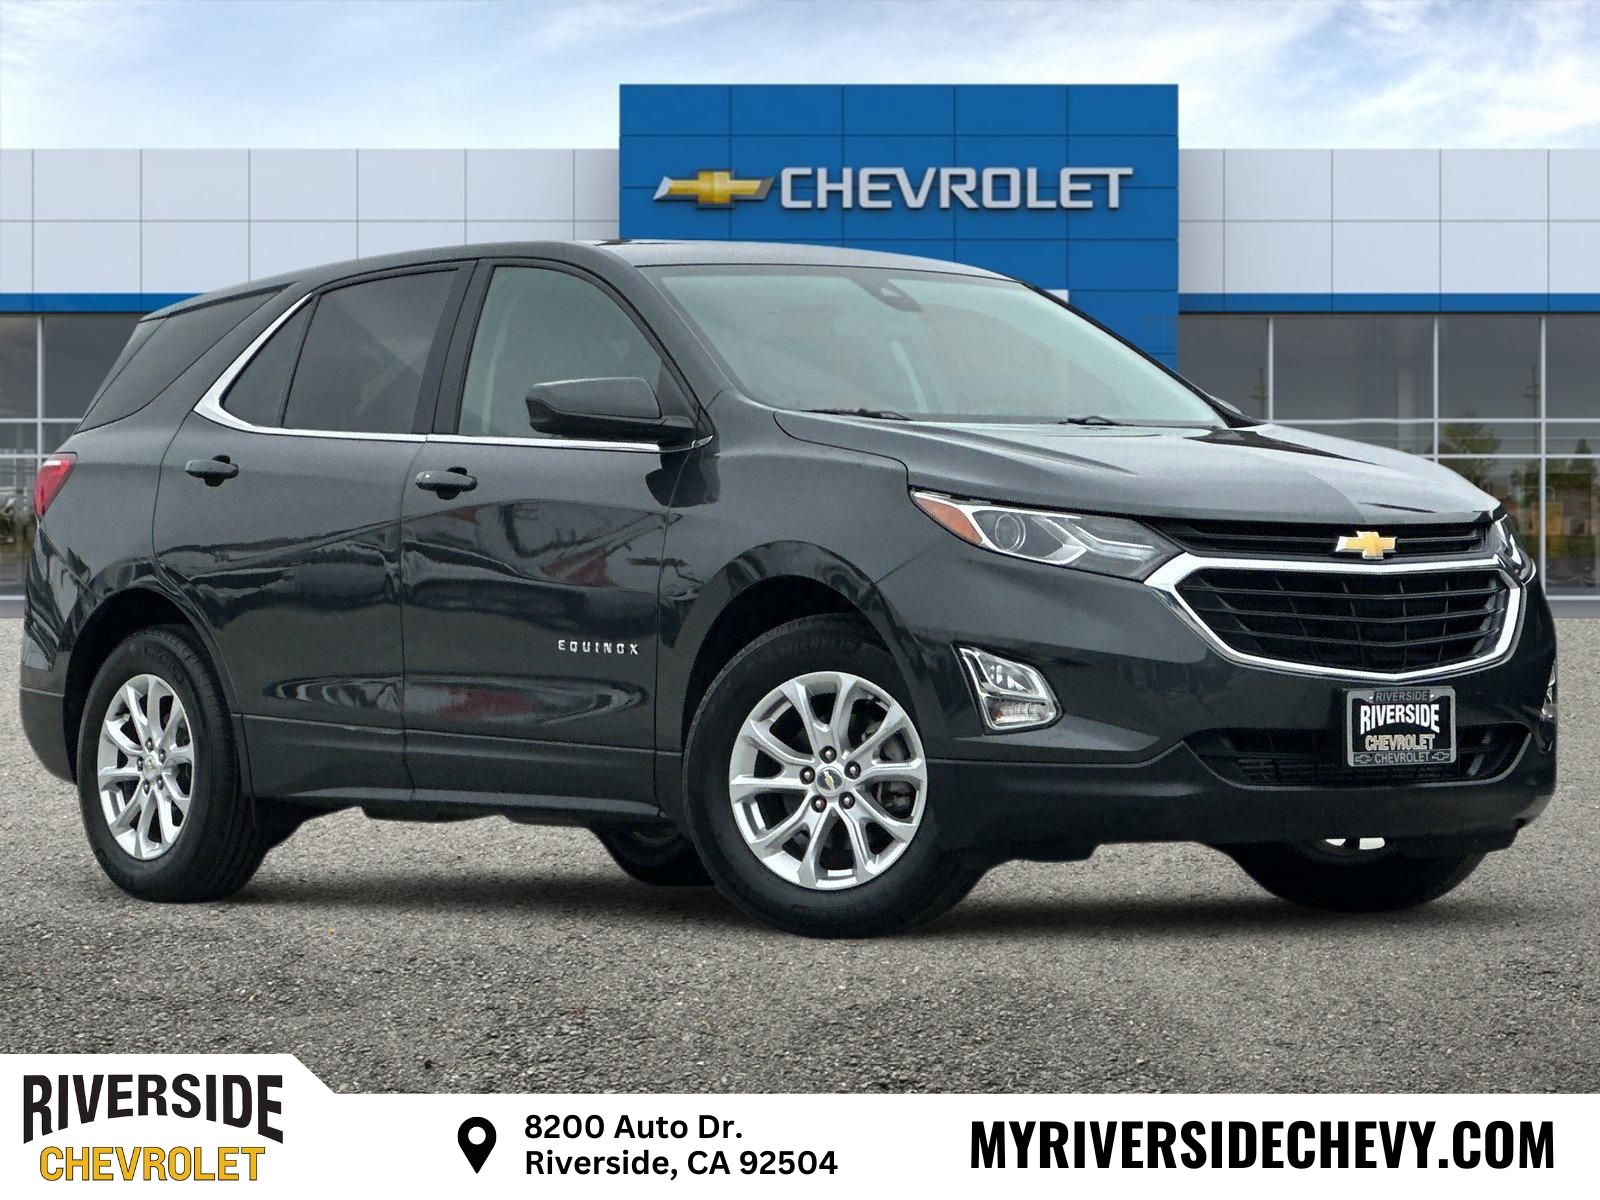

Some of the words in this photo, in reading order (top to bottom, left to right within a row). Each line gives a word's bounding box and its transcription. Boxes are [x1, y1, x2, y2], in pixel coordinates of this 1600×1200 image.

[780, 167, 1134, 209] CHEVROLET
[558, 639, 639, 655] EQUINOX
[1375, 691, 1428, 702] RIVERSIDE
[1360, 703, 1440, 735] RIVERSIDE
[1364, 733, 1435, 751] CHEVROLET
[1374, 751, 1430, 764] CHEVROLET
